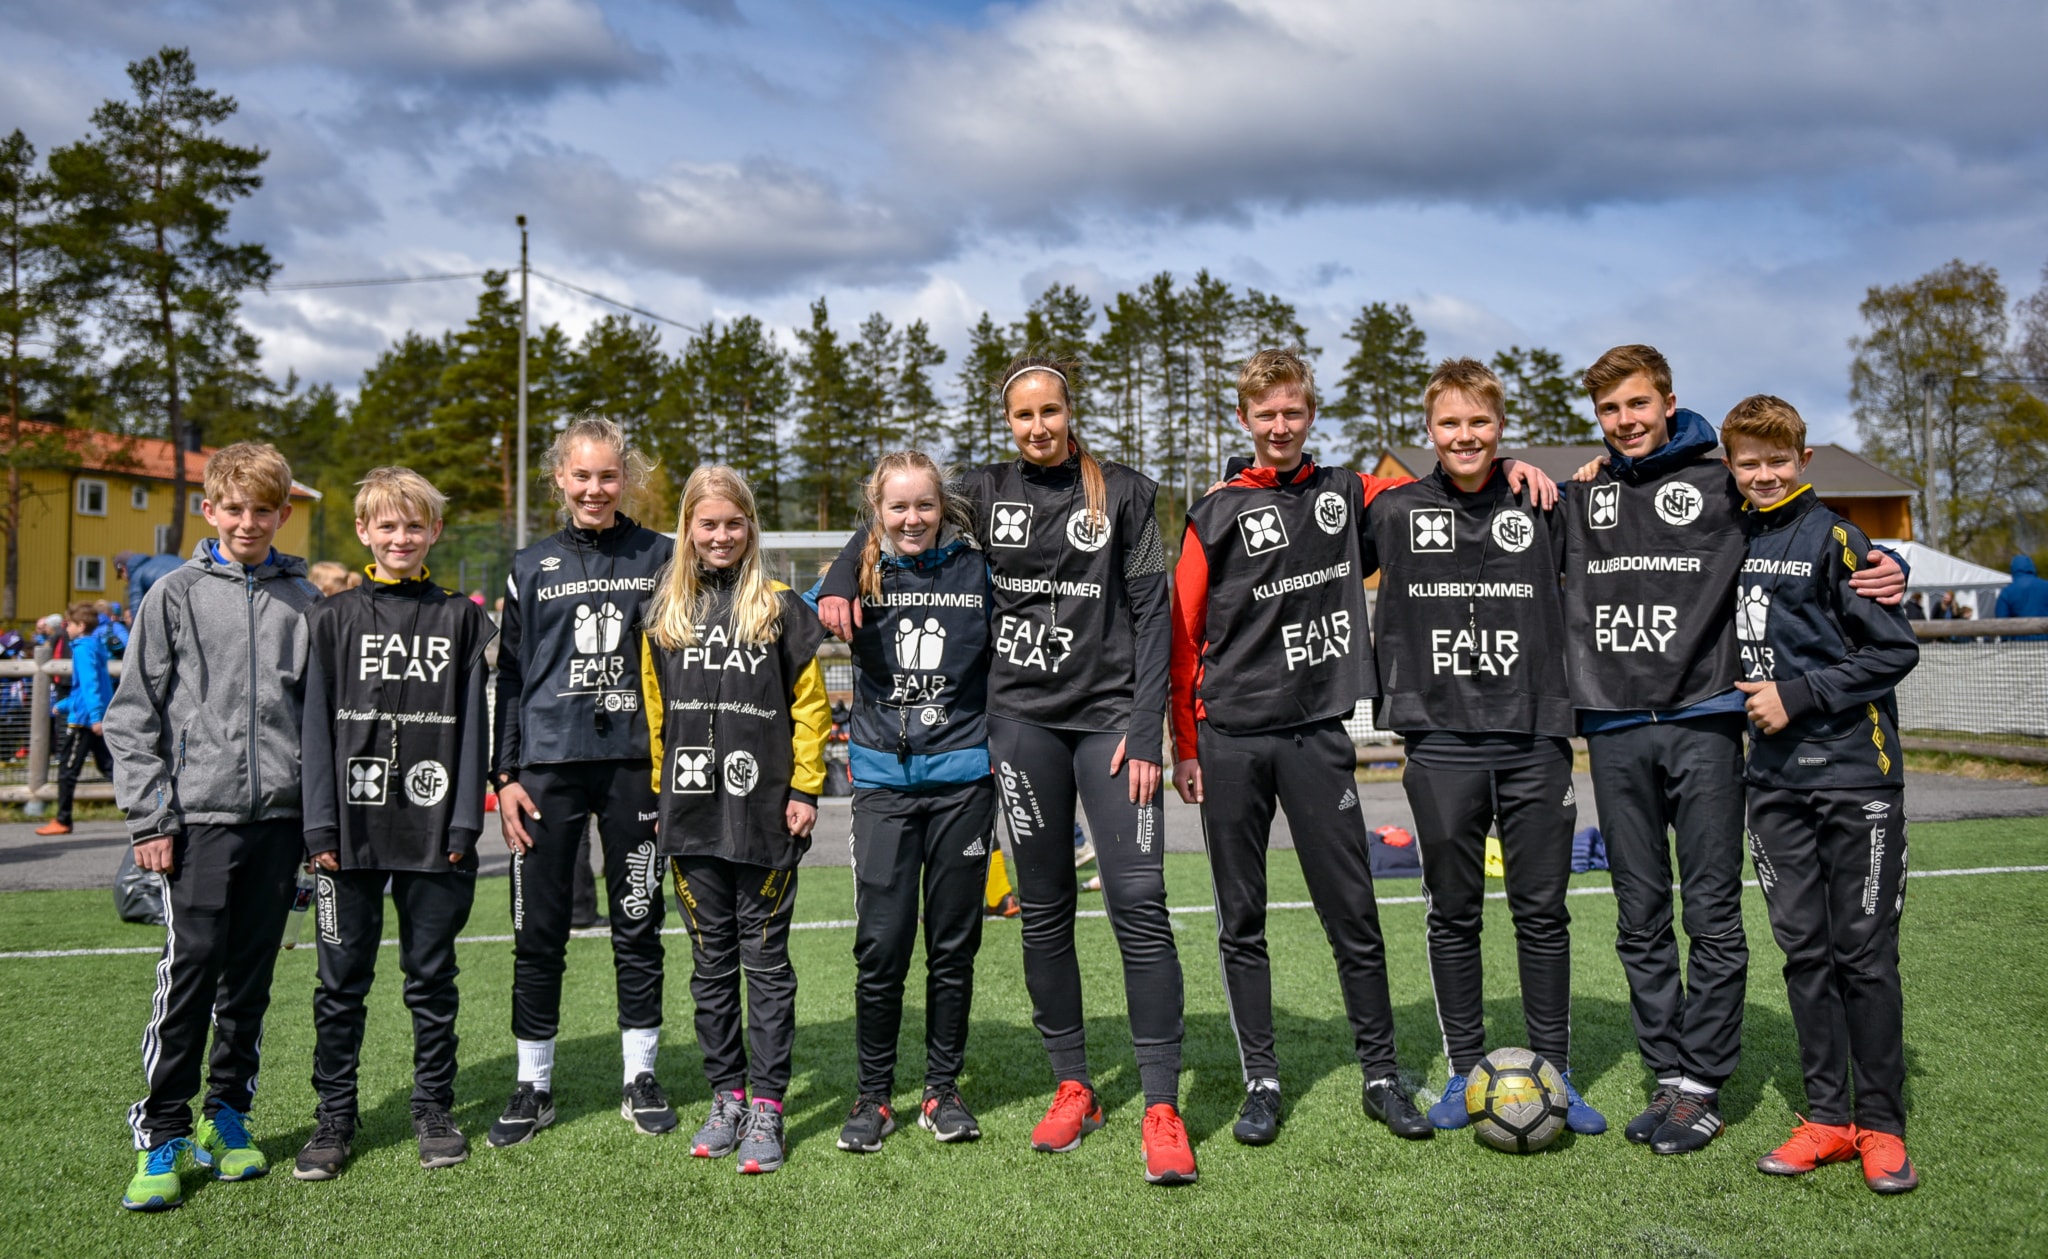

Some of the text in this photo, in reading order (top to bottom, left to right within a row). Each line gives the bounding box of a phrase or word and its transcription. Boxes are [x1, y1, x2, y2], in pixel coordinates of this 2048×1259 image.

[1587, 556, 1701, 574] KLUBBDOMMER
[1741, 558, 1812, 577] DOMMER
[537, 577, 656, 602] KLUBBDOMMER
[992, 573, 1101, 599] KLUBBDOMMER
[1252, 561, 1350, 600] KLUBBDOMMER
[1409, 583, 1533, 598] KLUBBDOMMER
[861, 592, 983, 608] KLUBBDOMMER
[1281, 610, 1350, 648] FAIR
[1596, 604, 1677, 629] FAIR
[1001, 615, 1074, 651] FAIR
[1432, 629, 1519, 652] FAIR
[1596, 628, 1677, 652] PLAY
[360, 634, 451, 660] FAIR
[996, 637, 1072, 673] PLAY
[1286, 630, 1350, 671] PLAY
[1741, 646, 1775, 663] AIR
[360, 657, 449, 682] PLAY
[571, 656, 624, 673] FAIR
[683, 647, 767, 675] PLAY
[1432, 652, 1519, 675] PLAY
[1745, 662, 1775, 679] AY
[569, 671, 624, 688] PLAY
[892, 674, 946, 689] FAIR
[890, 687, 944, 701] PLAY
[1029, 797, 1045, 828] BURGERS
[1141, 803, 1155, 852] setning
[620, 840, 656, 920] Pernille
[1864, 828, 1886, 915] Dekkomsetning
[319, 897, 327, 930] OLSEN
[324, 897, 334, 933] HENNIG
